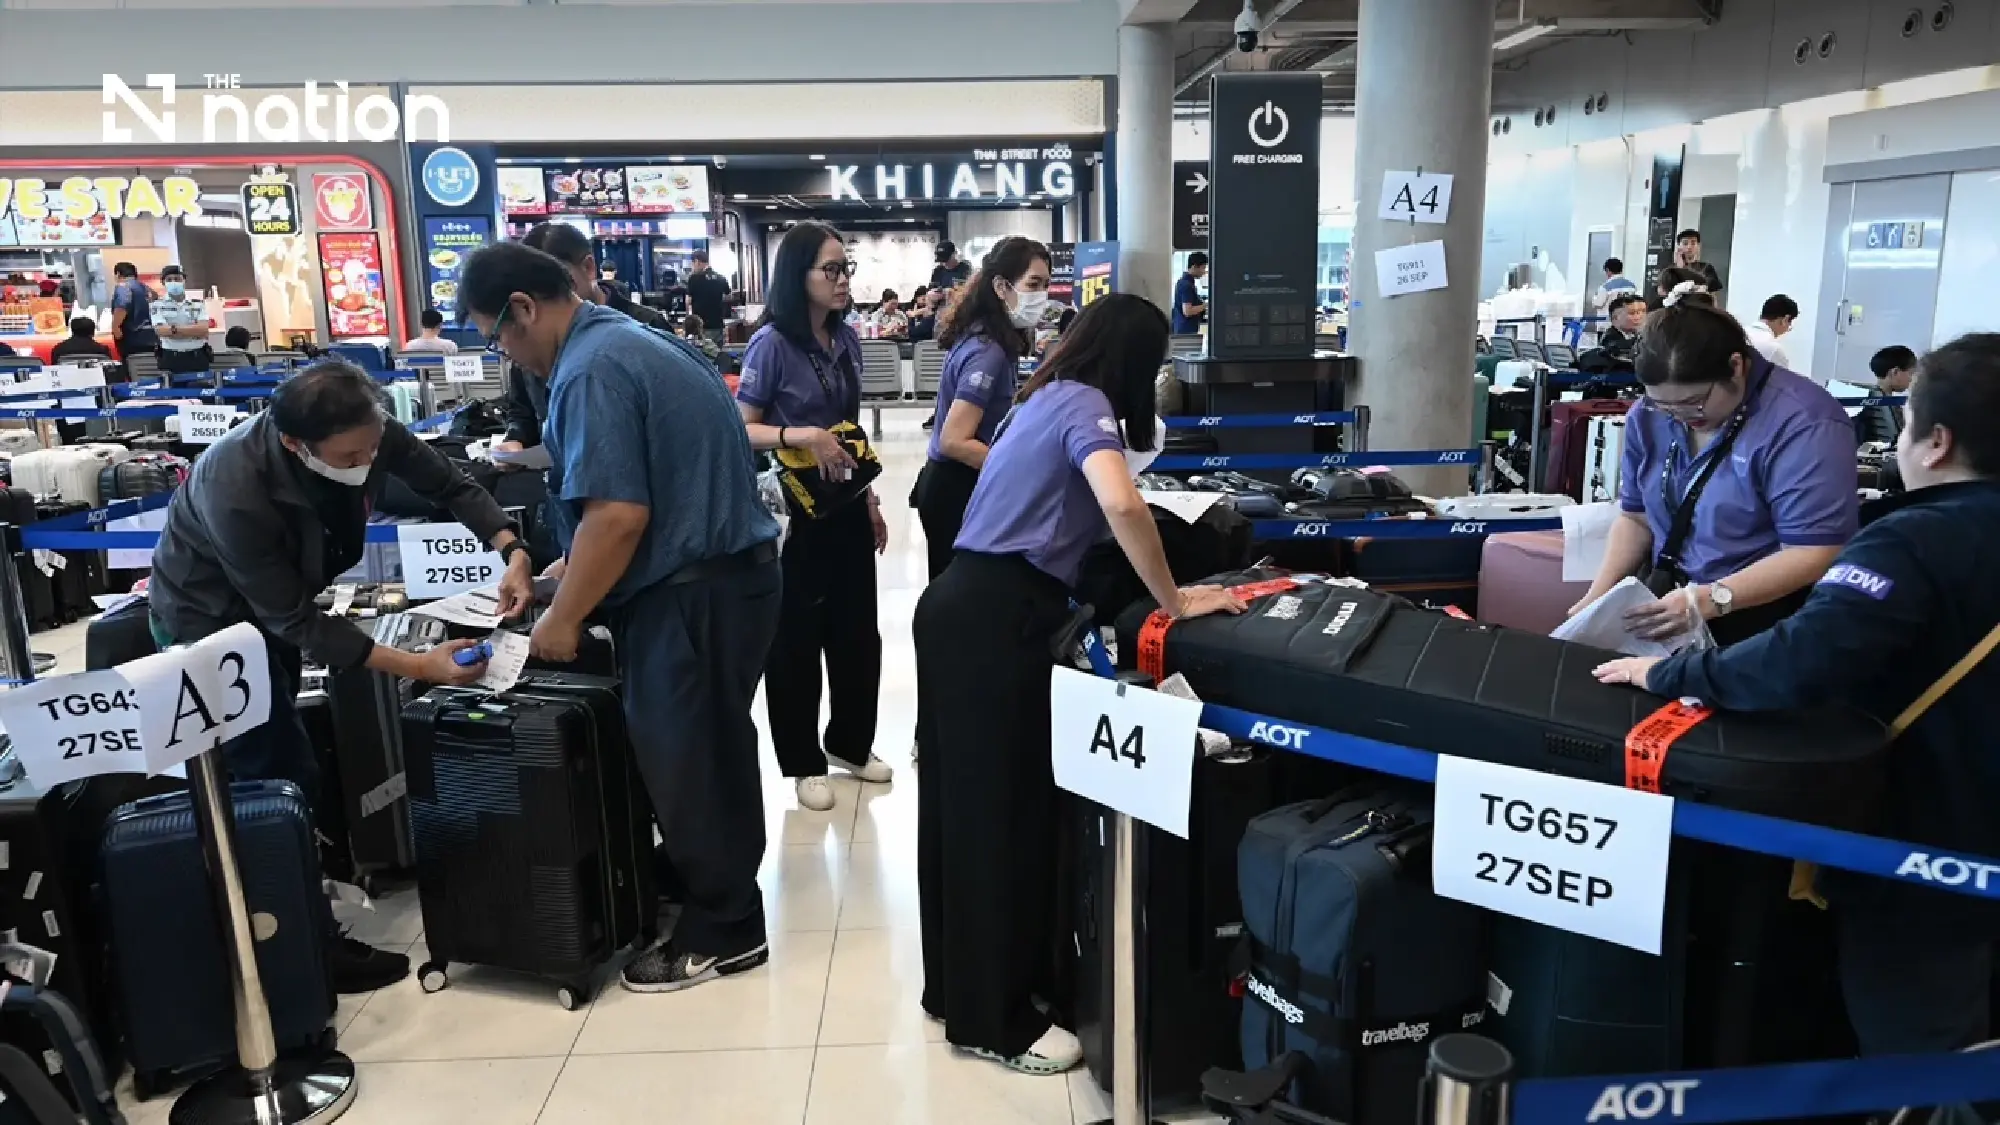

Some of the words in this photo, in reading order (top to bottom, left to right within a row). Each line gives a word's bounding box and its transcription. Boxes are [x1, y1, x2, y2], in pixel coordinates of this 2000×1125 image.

[974, 149, 997, 160] THAI
[1001, 149, 1038, 160] STREET
[1042, 149, 1072, 160] FOOD
[1232, 154, 1256, 164] FREE
[1257, 154, 1303, 164] CHARGING
[251, 185, 286, 196] OPEN
[825, 162, 1074, 200] KHIANG
[61, 176, 204, 219] STAR
[1389, 182, 1439, 214] A4
[250, 197, 292, 221] 24
[253, 221, 292, 232] HOURS
[191, 411, 226, 423] TG619
[1198, 417, 1222, 426] AOT
[1294, 415, 1316, 424] AOT
[191, 426, 227, 437] 26SEP
[1202, 456, 1230, 466] AOT
[1322, 455, 1349, 464] AOT
[1438, 452, 1466, 462] AOT
[1294, 522, 1331, 536] AOT
[1450, 521, 1487, 533] AOT
[425, 565, 492, 583] 27SEP
[165, 651, 250, 749] A3
[57, 728, 143, 760] 27SE
[1089, 712, 1147, 770] A4
[1248, 720, 1312, 749] AOT
[1479, 792, 1619, 851] TG657
[1475, 850, 1614, 907] 27SEP
[1895, 851, 2000, 890] AOT
[1247, 973, 1304, 1024] avelbags
[1362, 1021, 1430, 1046] travelbags
[1586, 1079, 1699, 1123] AOT
